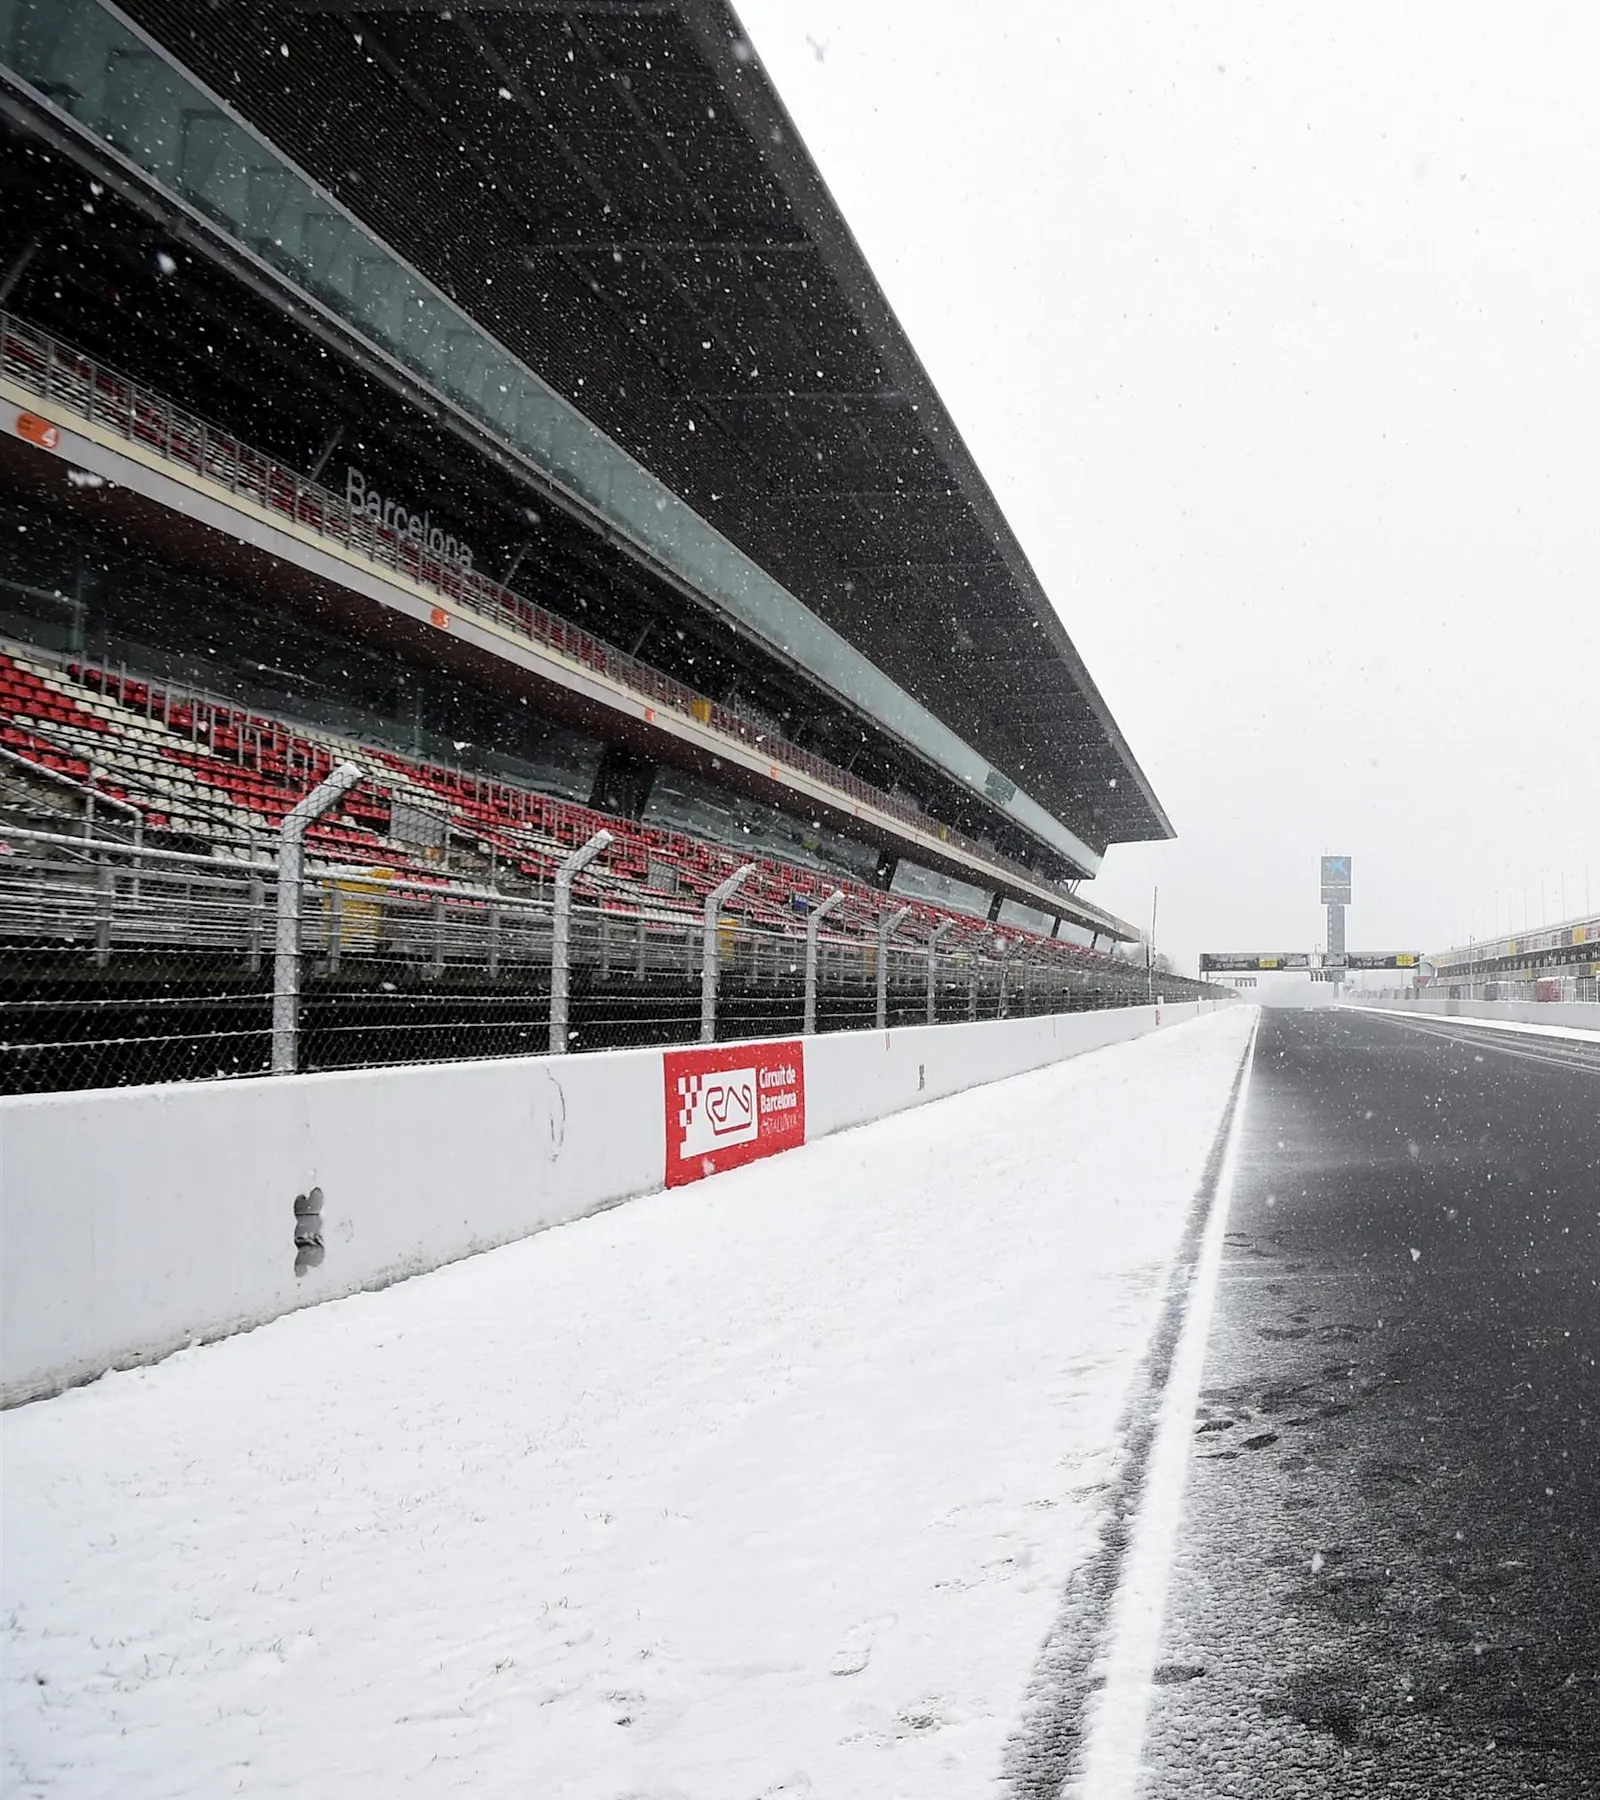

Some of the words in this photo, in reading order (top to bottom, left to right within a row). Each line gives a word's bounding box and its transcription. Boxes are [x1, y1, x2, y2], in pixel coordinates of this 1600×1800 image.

[41, 427, 58, 447] 4
[345, 466, 474, 570] Barcelona
[759, 1065, 786, 1089] Circuit
[786, 1063, 796, 1084] de
[760, 1089, 797, 1114] Barcelona
